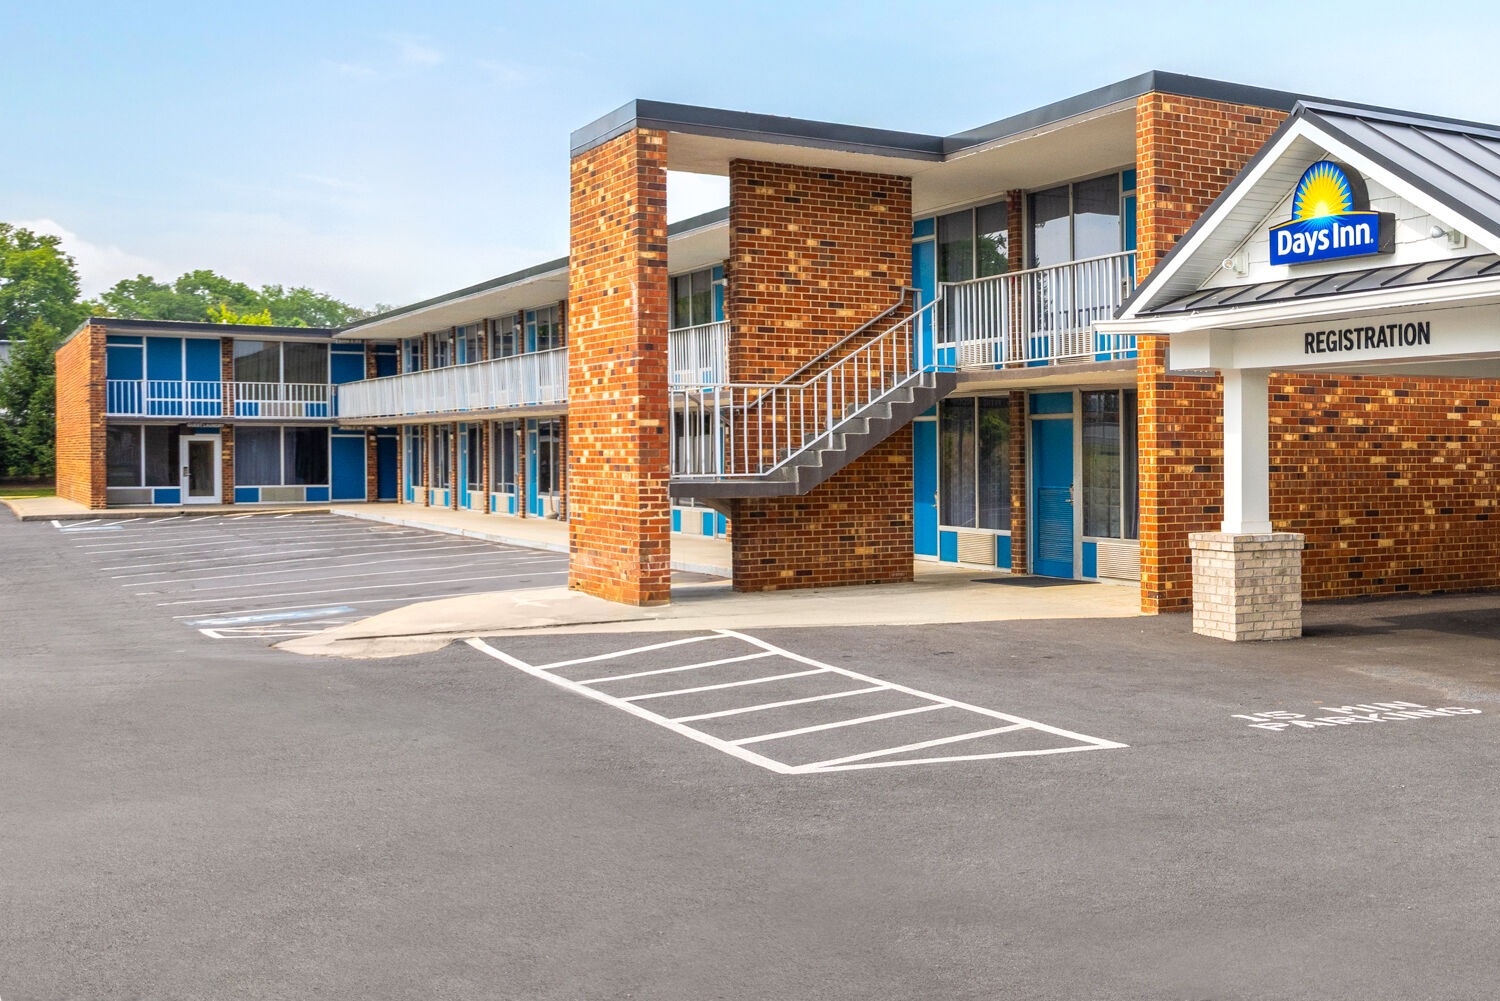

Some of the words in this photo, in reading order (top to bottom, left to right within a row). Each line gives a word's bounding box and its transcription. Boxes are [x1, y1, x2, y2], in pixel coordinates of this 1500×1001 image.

[1277, 228, 1330, 256] Days
[1333, 222, 1371, 249] Inn
[1304, 321, 1431, 354] REGISTRATION
[1248, 706, 1482, 731] PARKING
